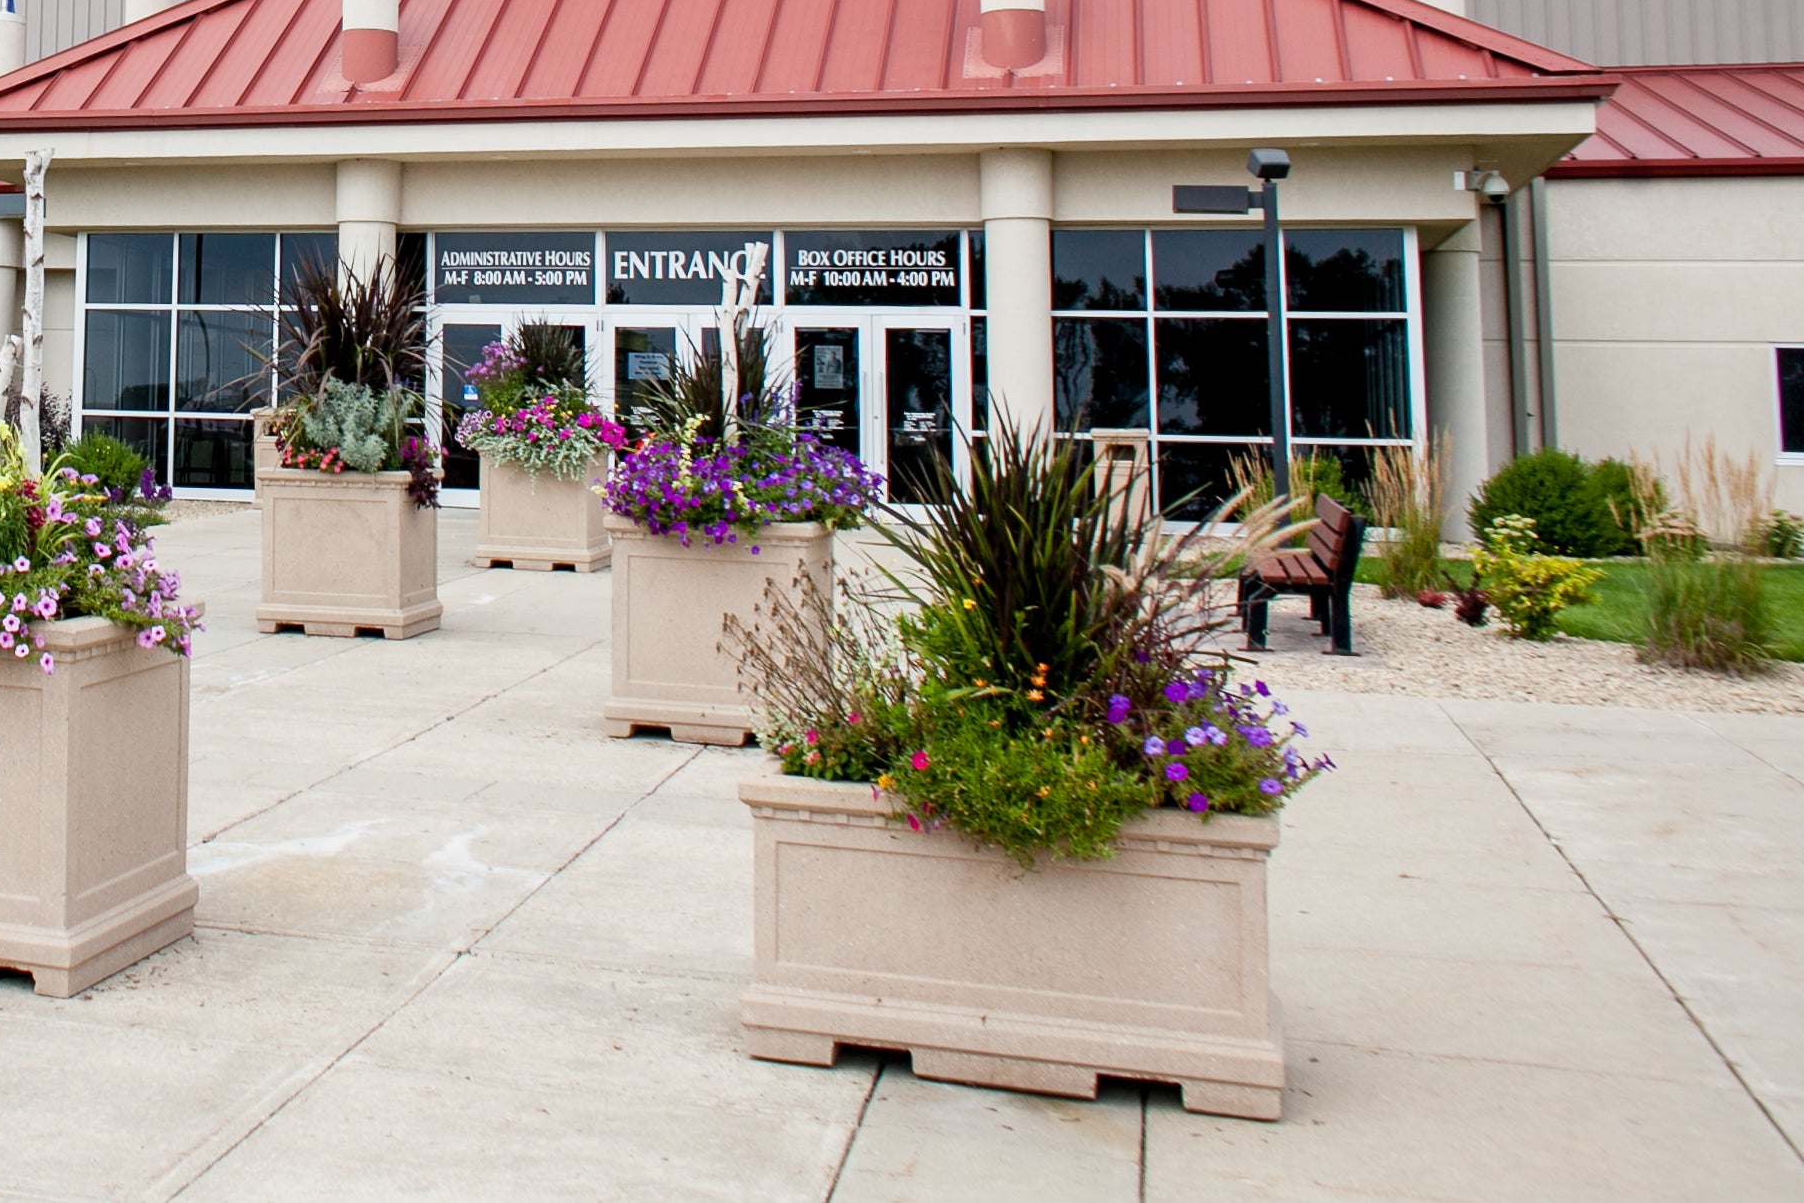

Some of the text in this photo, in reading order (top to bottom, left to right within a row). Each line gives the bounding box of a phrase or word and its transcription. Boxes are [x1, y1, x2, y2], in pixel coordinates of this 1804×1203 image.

[441, 250, 591, 266] ADMINISTRATIVE HOURS
[614, 249, 766, 280] ENTRANC
[797, 249, 946, 266] BOX OFFICE HOURS
[444, 270, 468, 285] M-F
[474, 270, 501, 285] 8:00
[503, 270, 526, 285] AM
[534, 270, 562, 285] 5:00
[566, 270, 587, 285] PM
[789, 270, 817, 286] M-F
[823, 270, 861, 286] 10:00
[862, 270, 888, 286] AM
[896, 270, 928, 286] 4:00
[931, 270, 956, 286] PM
